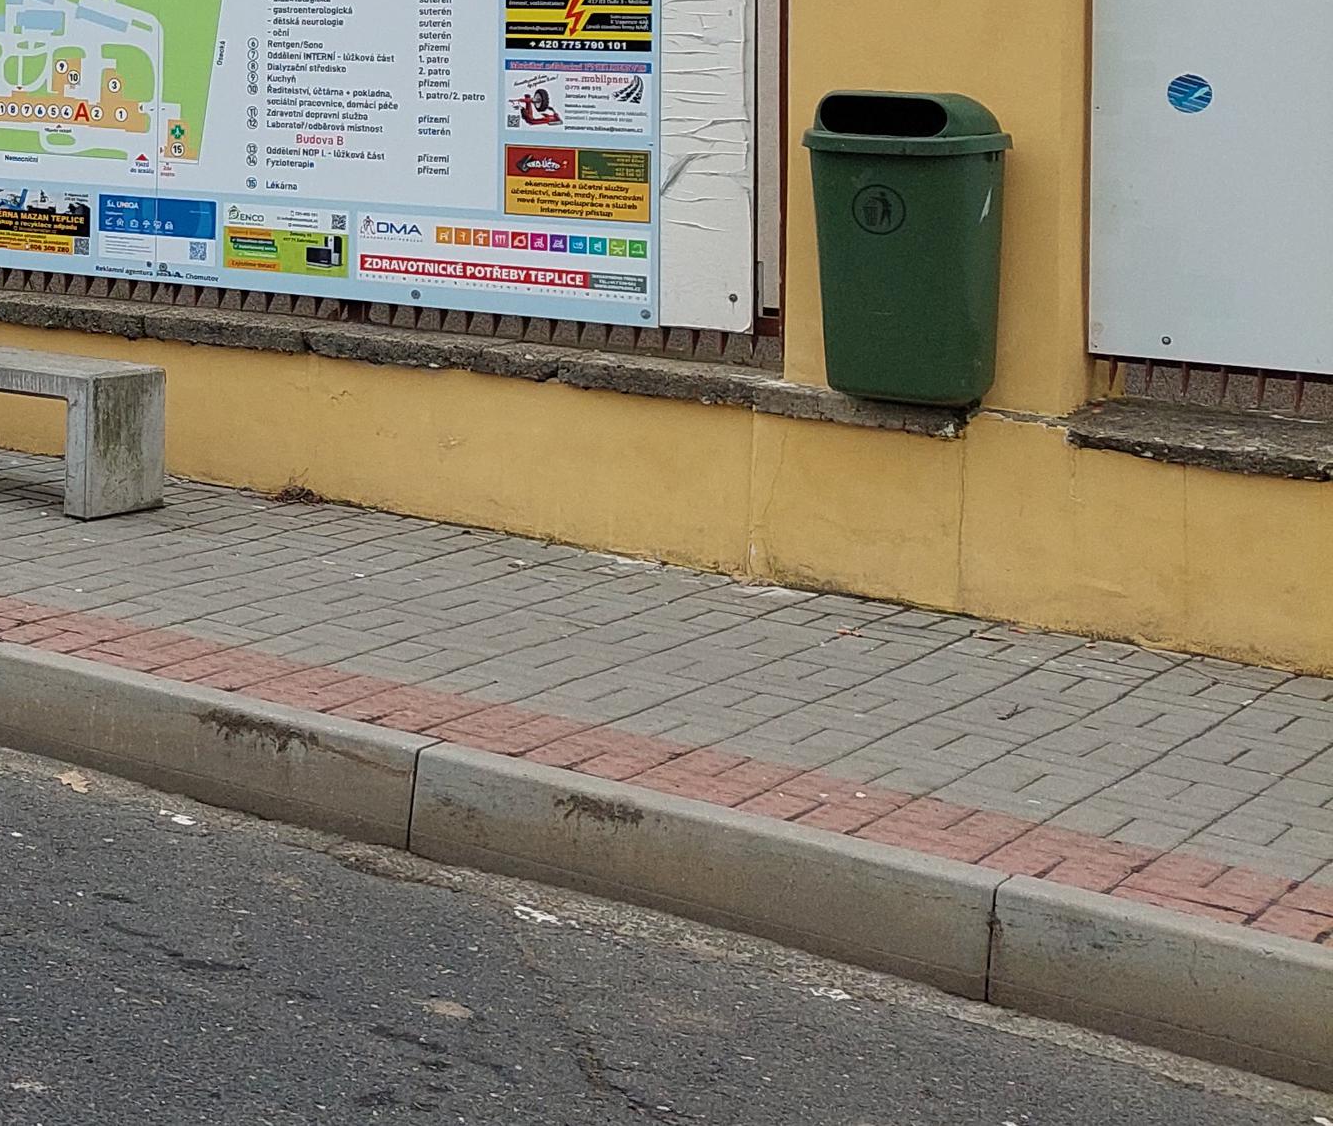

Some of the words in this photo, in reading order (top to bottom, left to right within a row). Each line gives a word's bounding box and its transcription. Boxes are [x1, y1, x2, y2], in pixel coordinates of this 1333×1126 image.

[273, 7, 353, 15] gastroenterologická
[302, 18, 343, 27] neurologie
[268, 40, 323, 50] Rentgen/Sono
[561, 41, 581, 49] 775
[584, 41, 604, 49] 790
[607, 42, 627, 50] 101
[268, 51, 302, 60] Oddělení
[303, 50, 335, 60] INTERNÍ
[343, 53, 374, 62] lůžková
[377, 54, 394, 62] část
[267, 63, 307, 72] Dialyzační
[309, 64, 346, 73] středisko
[419, 67, 426, 75] 2.
[427, 68, 450, 77] patro
[267, 74, 296, 84] Kuchyň
[582, 75, 629, 85] mobilpneu
[267, 85, 310, 95] Ředitelství,
[313, 87, 344, 96] účtárna
[353, 88, 392, 99] pokladna,
[267, 97, 297, 106] sociální
[299, 99, 344, 109] pracovnice,
[347, 100, 376, 108] domácí
[378, 101, 398, 110] péče
[74, 103, 90, 121] A
[267, 109, 303, 118] Zdravotní
[305, 109, 340, 120] dopravní
[342, 111, 368, 120] služba
[267, 120, 345, 131] Laboratoř/odběrová
[347, 123, 383, 133] místnost
[418, 128, 451, 136] suterén
[296, 134, 333, 144] Budova
[336, 135, 344, 145] B
[5, 155, 38, 163] Nemocniční
[266, 158, 314, 169] Fyzioterapie
[266, 180, 297, 190] Lékárna
[51, 214, 85, 224] TEPLICE
[377, 222, 422, 236] DMA
[96, 265, 124, 275] Reklamní
[127, 268, 153, 276] agentura
[364, 256, 464, 276] ZDRAVOTNICKÉ
[467, 265, 526, 281] POTŘEBY
[529, 271, 583, 285] TEPLICE
[185, 273, 219, 283] Chomutov
